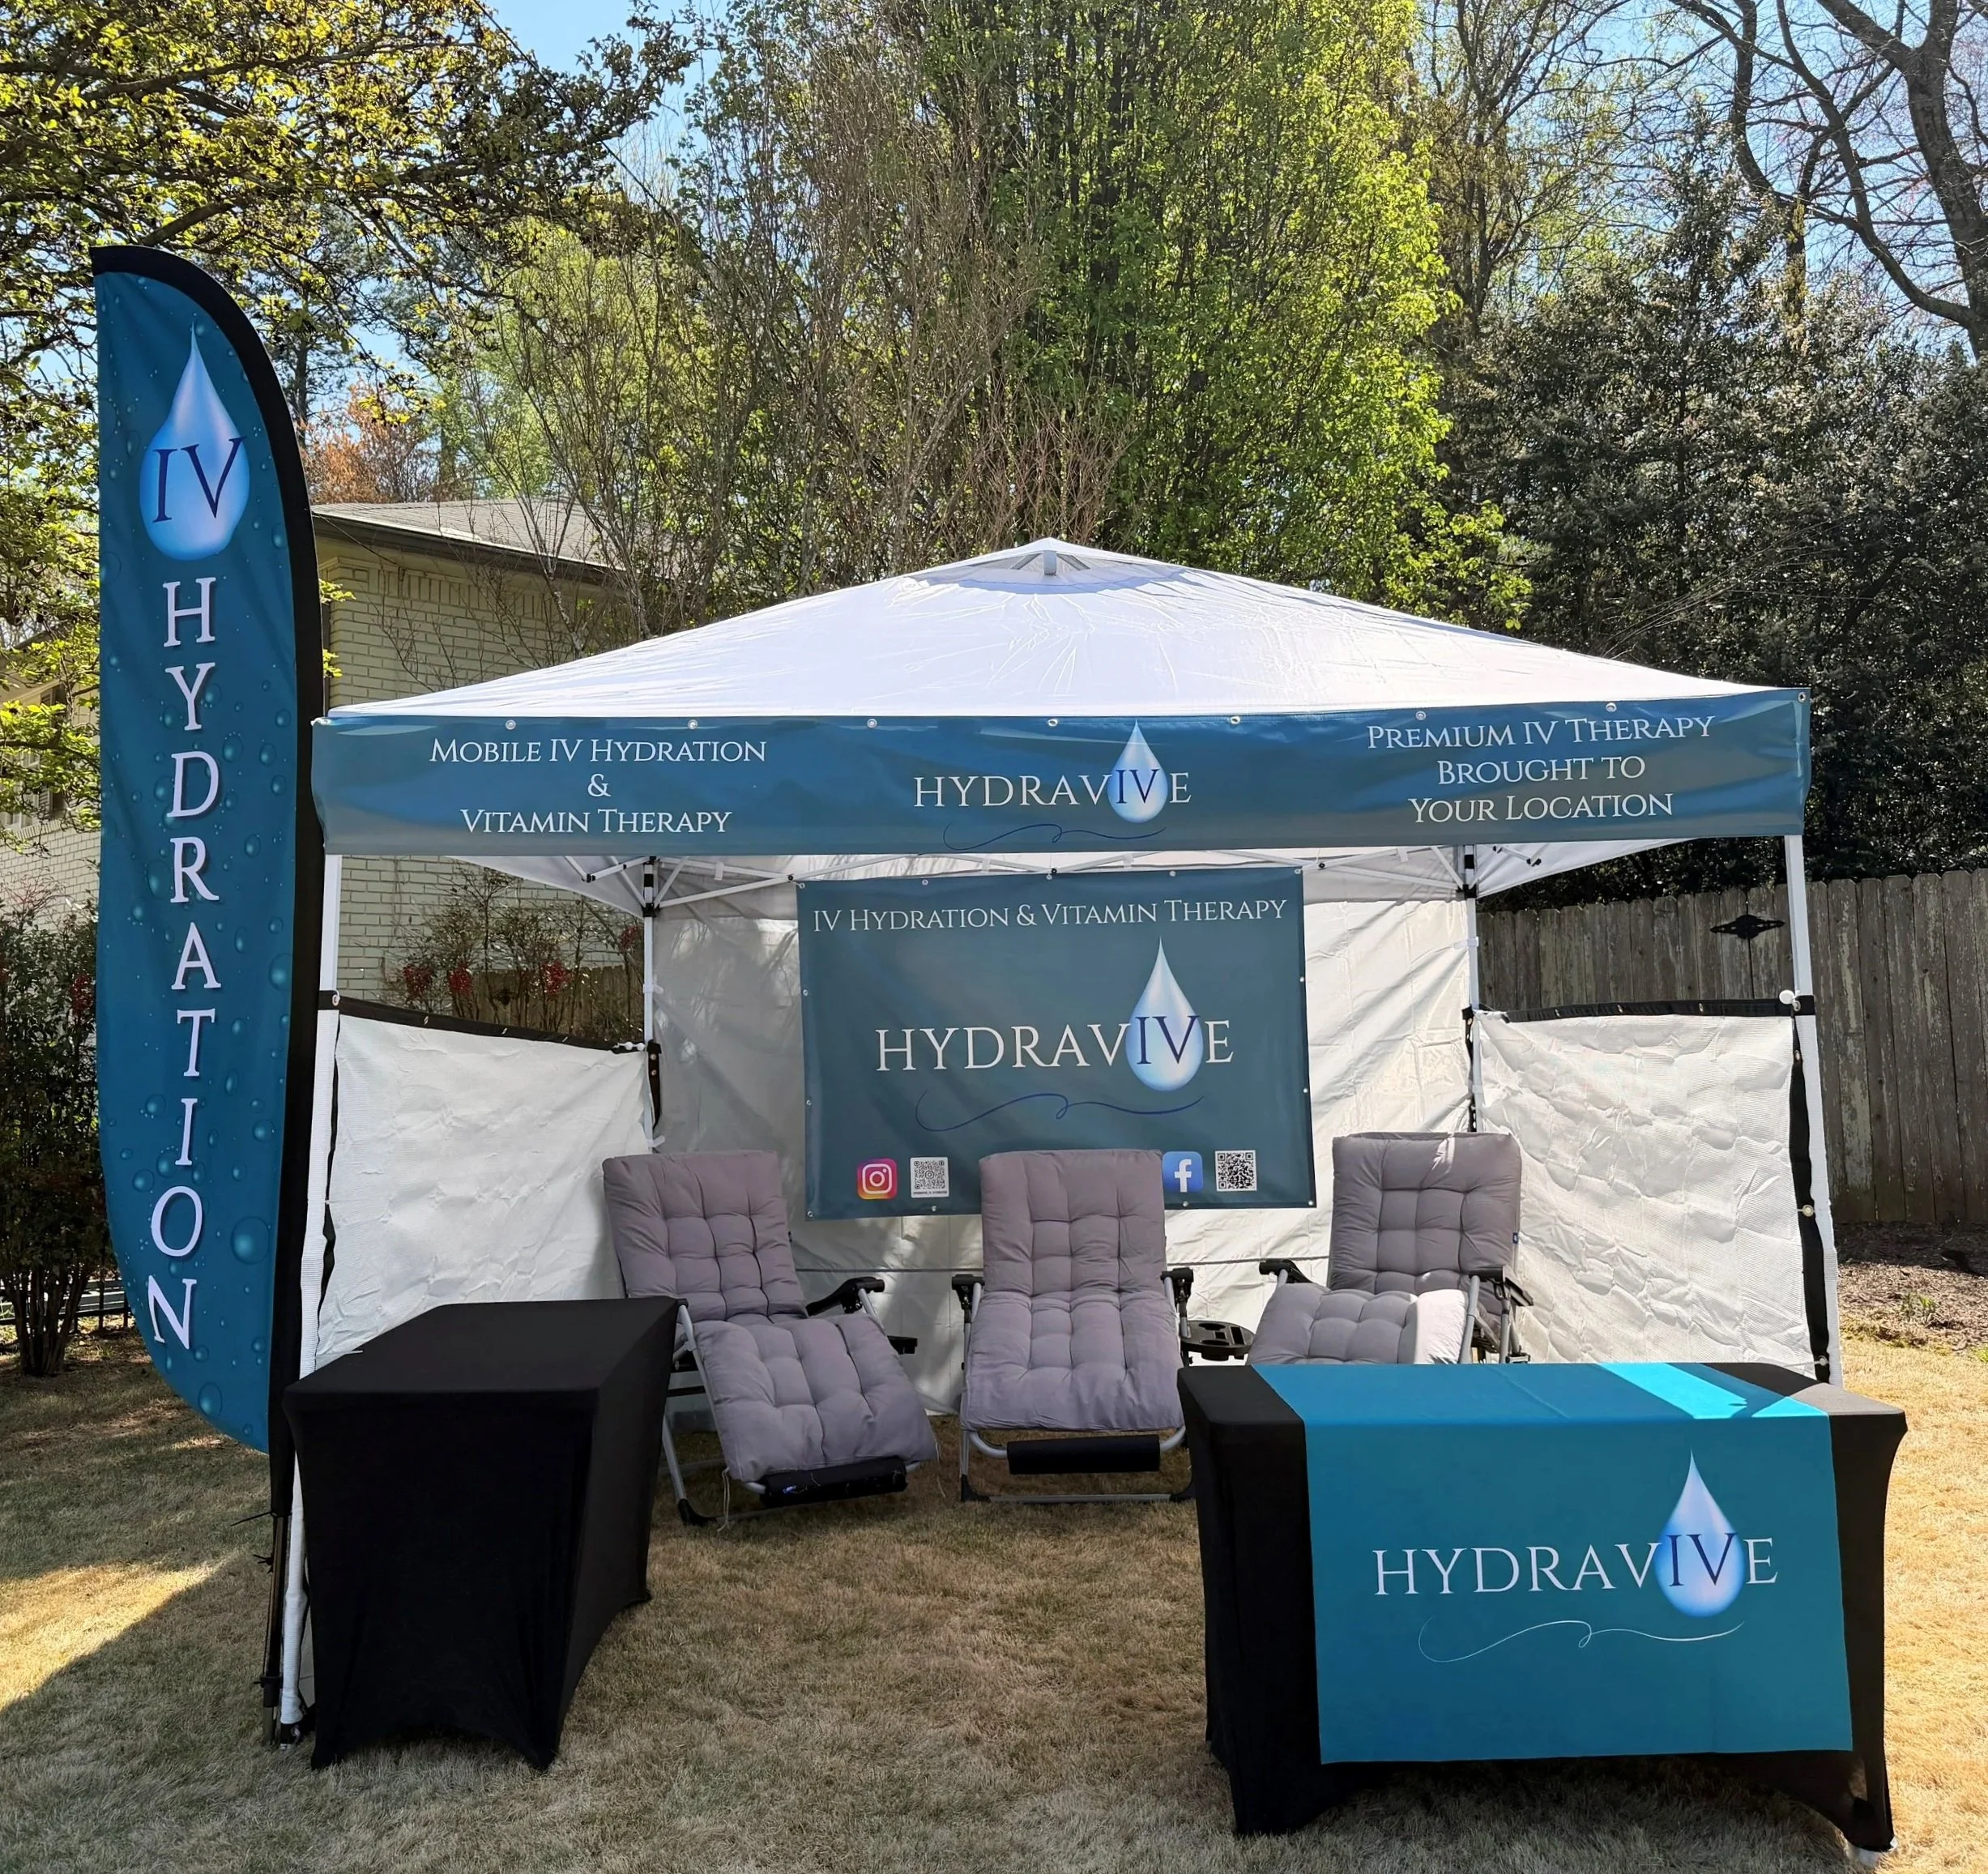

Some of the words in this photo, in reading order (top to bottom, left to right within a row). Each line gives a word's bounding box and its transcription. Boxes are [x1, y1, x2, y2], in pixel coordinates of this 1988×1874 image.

[152, 436, 247, 523] IV
[1367, 724, 1517, 749] PREMIUM
[1522, 720, 1558, 745] IV
[1564, 715, 1717, 744] THERAPY
[429, 738, 541, 762] MOBILE
[549, 738, 582, 762] IV
[590, 739, 767, 762] HYDRATION
[587, 773, 611, 797] &
[1436, 758, 1594, 786] BROUGHT
[1601, 756, 1646, 779] TO
[913, 769, 1192, 808] HYDRAVIVE
[460, 809, 589, 834] VITAMIN
[597, 809, 732, 834] THERAPY
[1408, 796, 1498, 824] YOUR
[1506, 792, 1674, 821] LOCATION
[813, 910, 841, 933] IV
[849, 907, 1009, 932] HYDRATION
[1016, 903, 1037, 926] &
[1040, 902, 1158, 925] VITAMIN
[1163, 899, 1287, 923] THERAPY
[147, 576, 222, 1351] HYDRATION
[875, 1015, 1234, 1071] HYDRAVIVE
[1372, 1533, 1778, 1595] HYDRAVIVE
